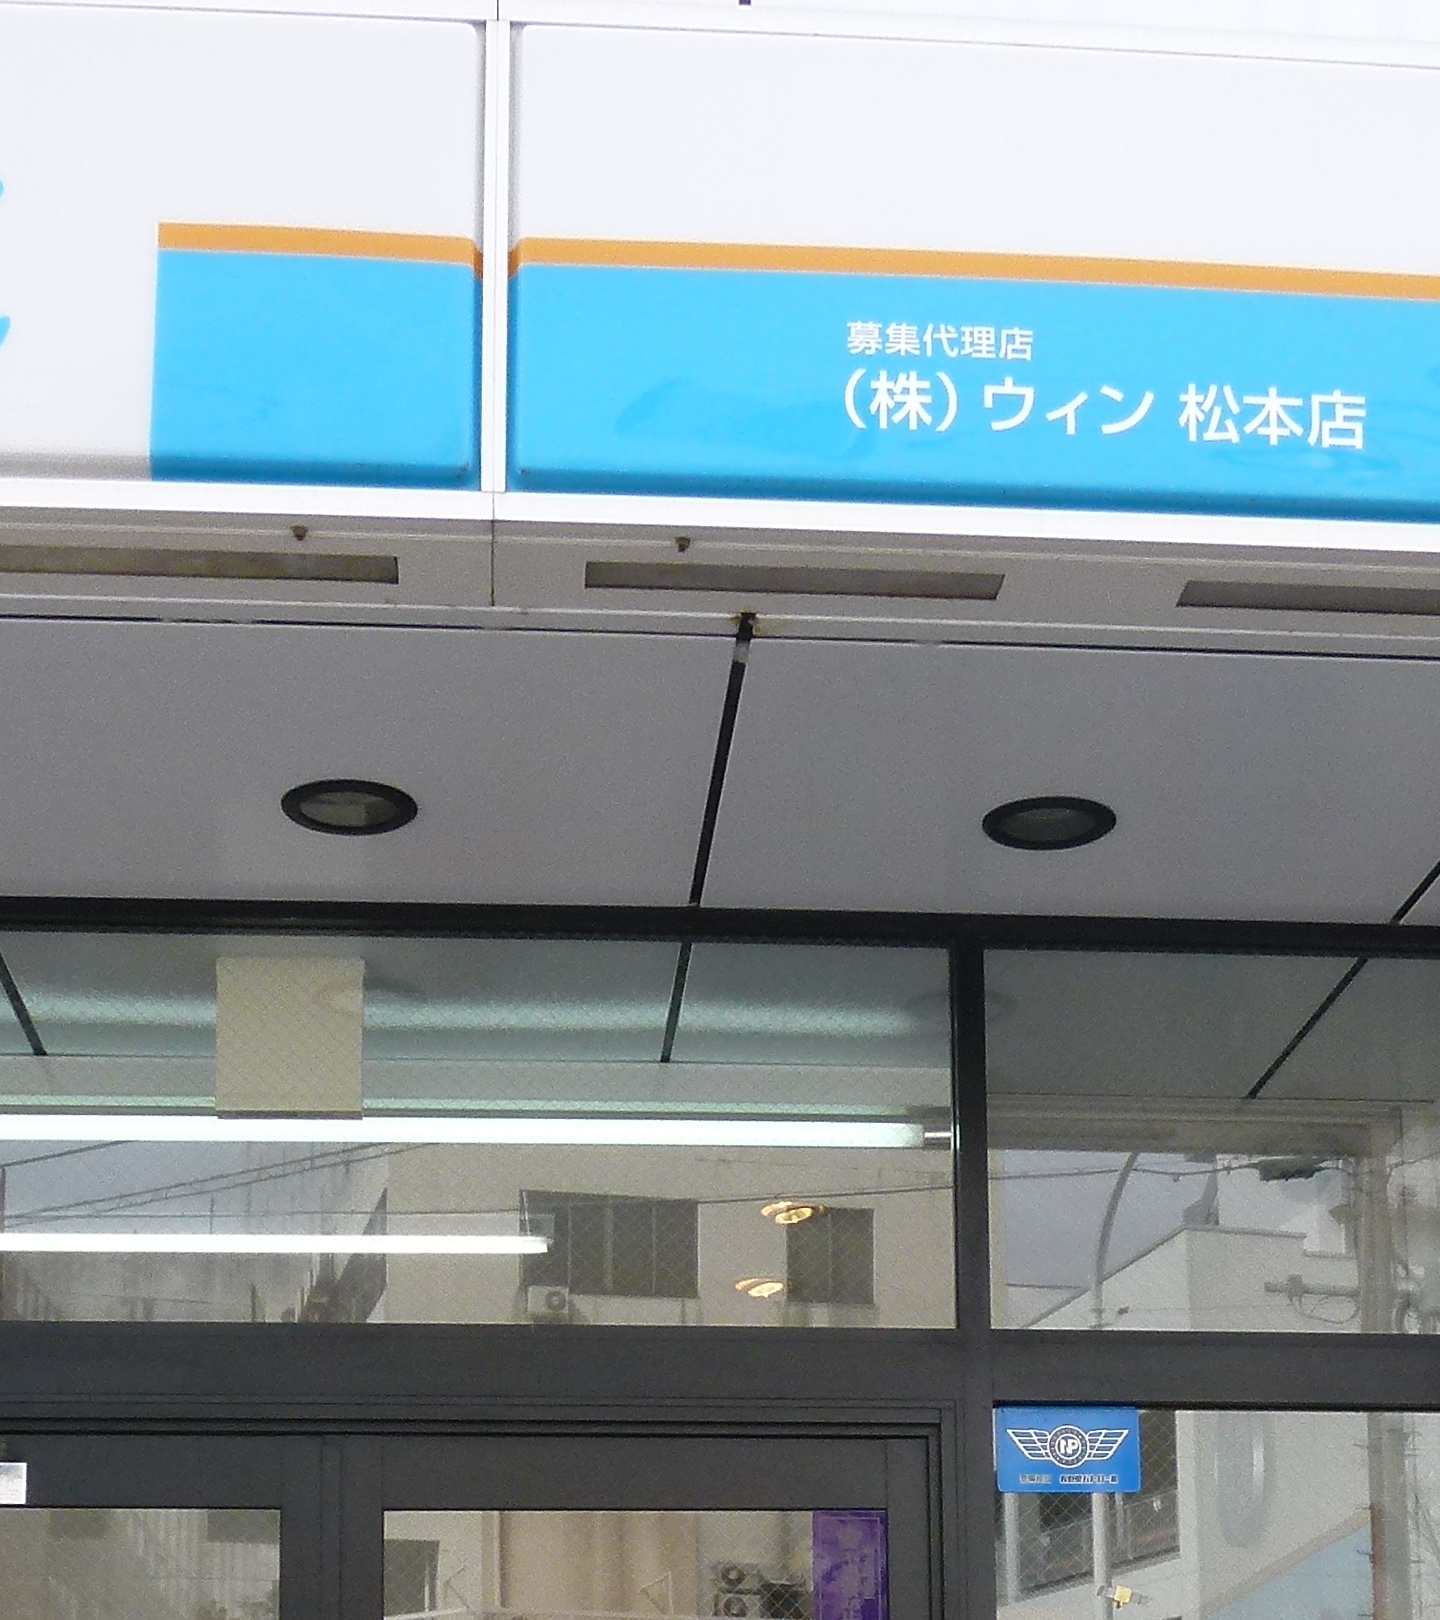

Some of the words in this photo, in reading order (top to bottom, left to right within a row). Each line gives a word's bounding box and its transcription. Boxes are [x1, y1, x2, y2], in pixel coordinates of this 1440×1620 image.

[846, 320, 1034, 361] 募集代理店
[1179, 383, 1367, 449] 松本店
